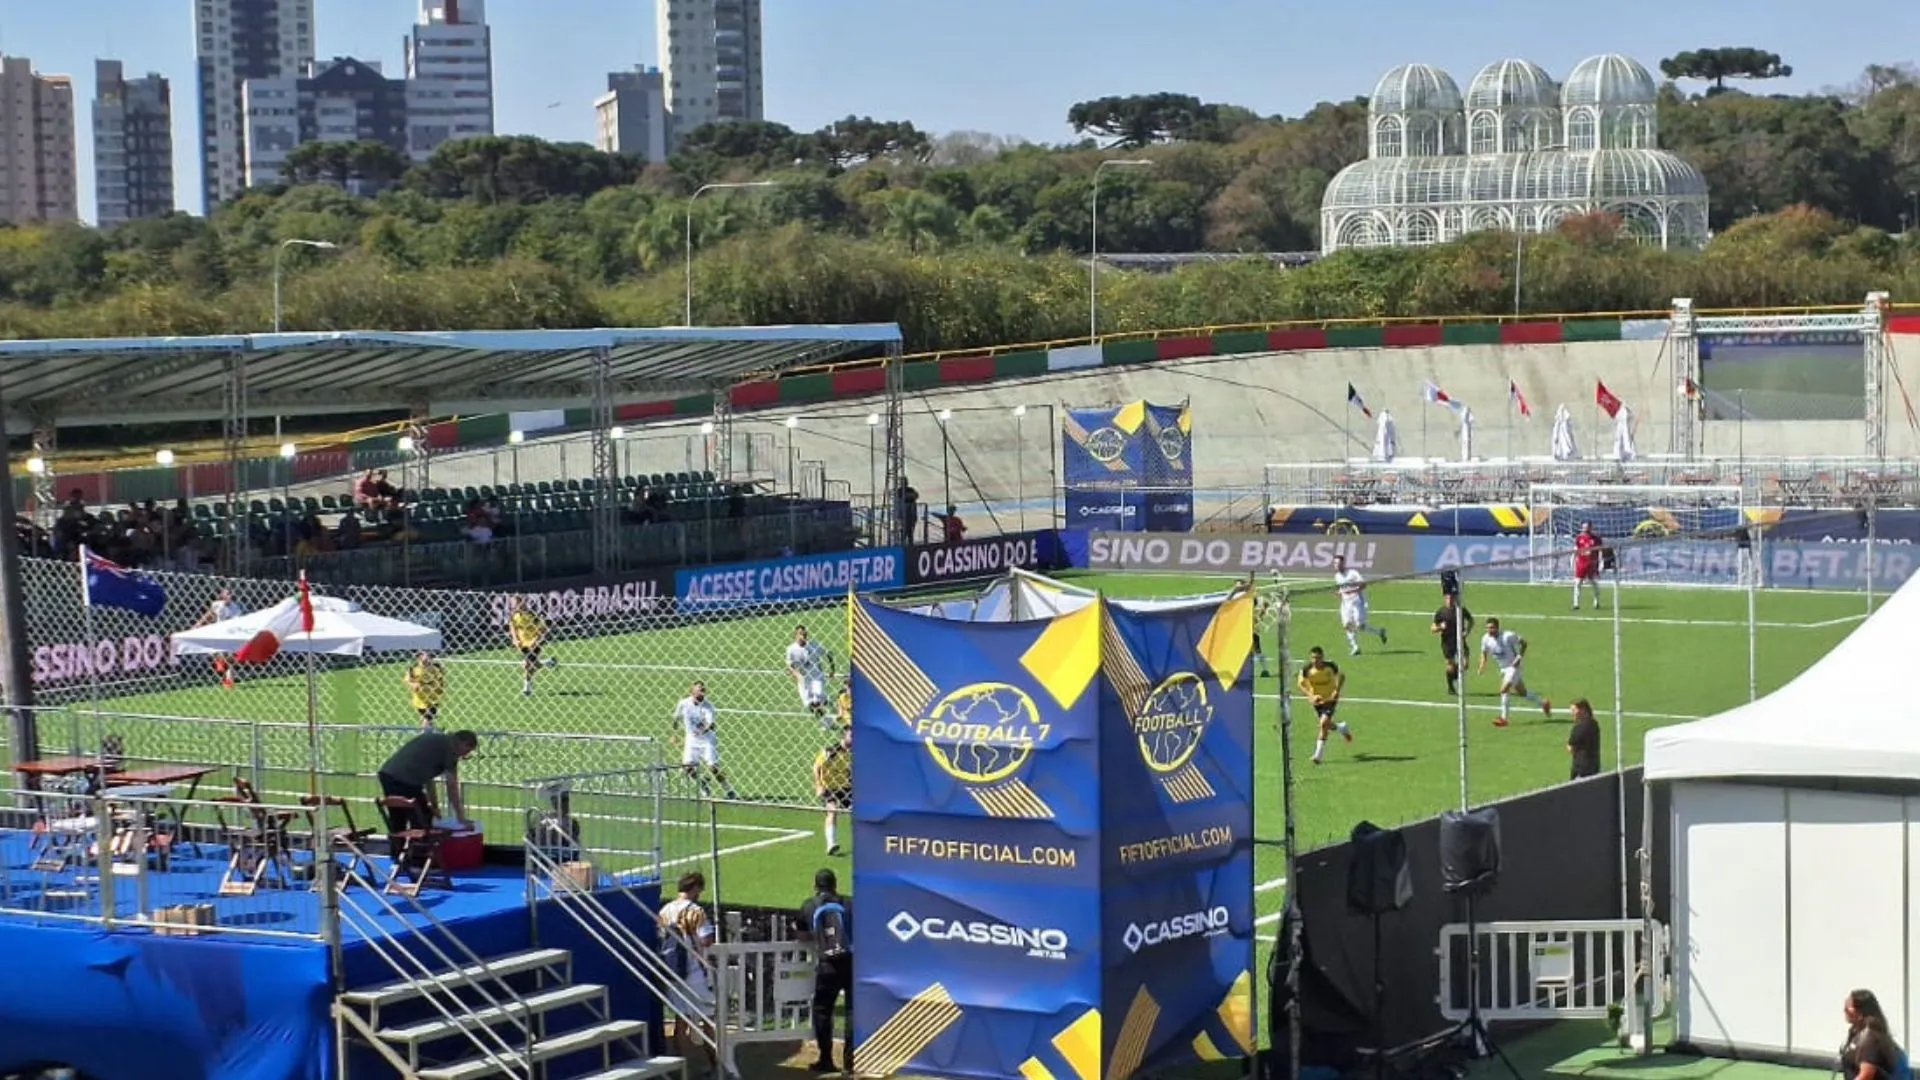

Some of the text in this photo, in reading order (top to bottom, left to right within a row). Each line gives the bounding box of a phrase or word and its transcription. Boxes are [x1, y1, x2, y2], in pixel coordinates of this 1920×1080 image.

[918, 551, 930, 577] O
[934, 543, 999, 575] CASSINO
[1004, 541, 1026, 567] DO
[1090, 538, 1170, 564] SINO
[1179, 539, 1231, 565] DO
[687, 555, 895, 601] ACESSE CASSINO.BET.BR
[916, 719, 1051, 741] FOOTBALL 7
[1134, 705, 1213, 734] FOOTBALL 7
[922, 917, 1068, 951] CASSINO
[1144, 905, 1229, 945] CASSINO
